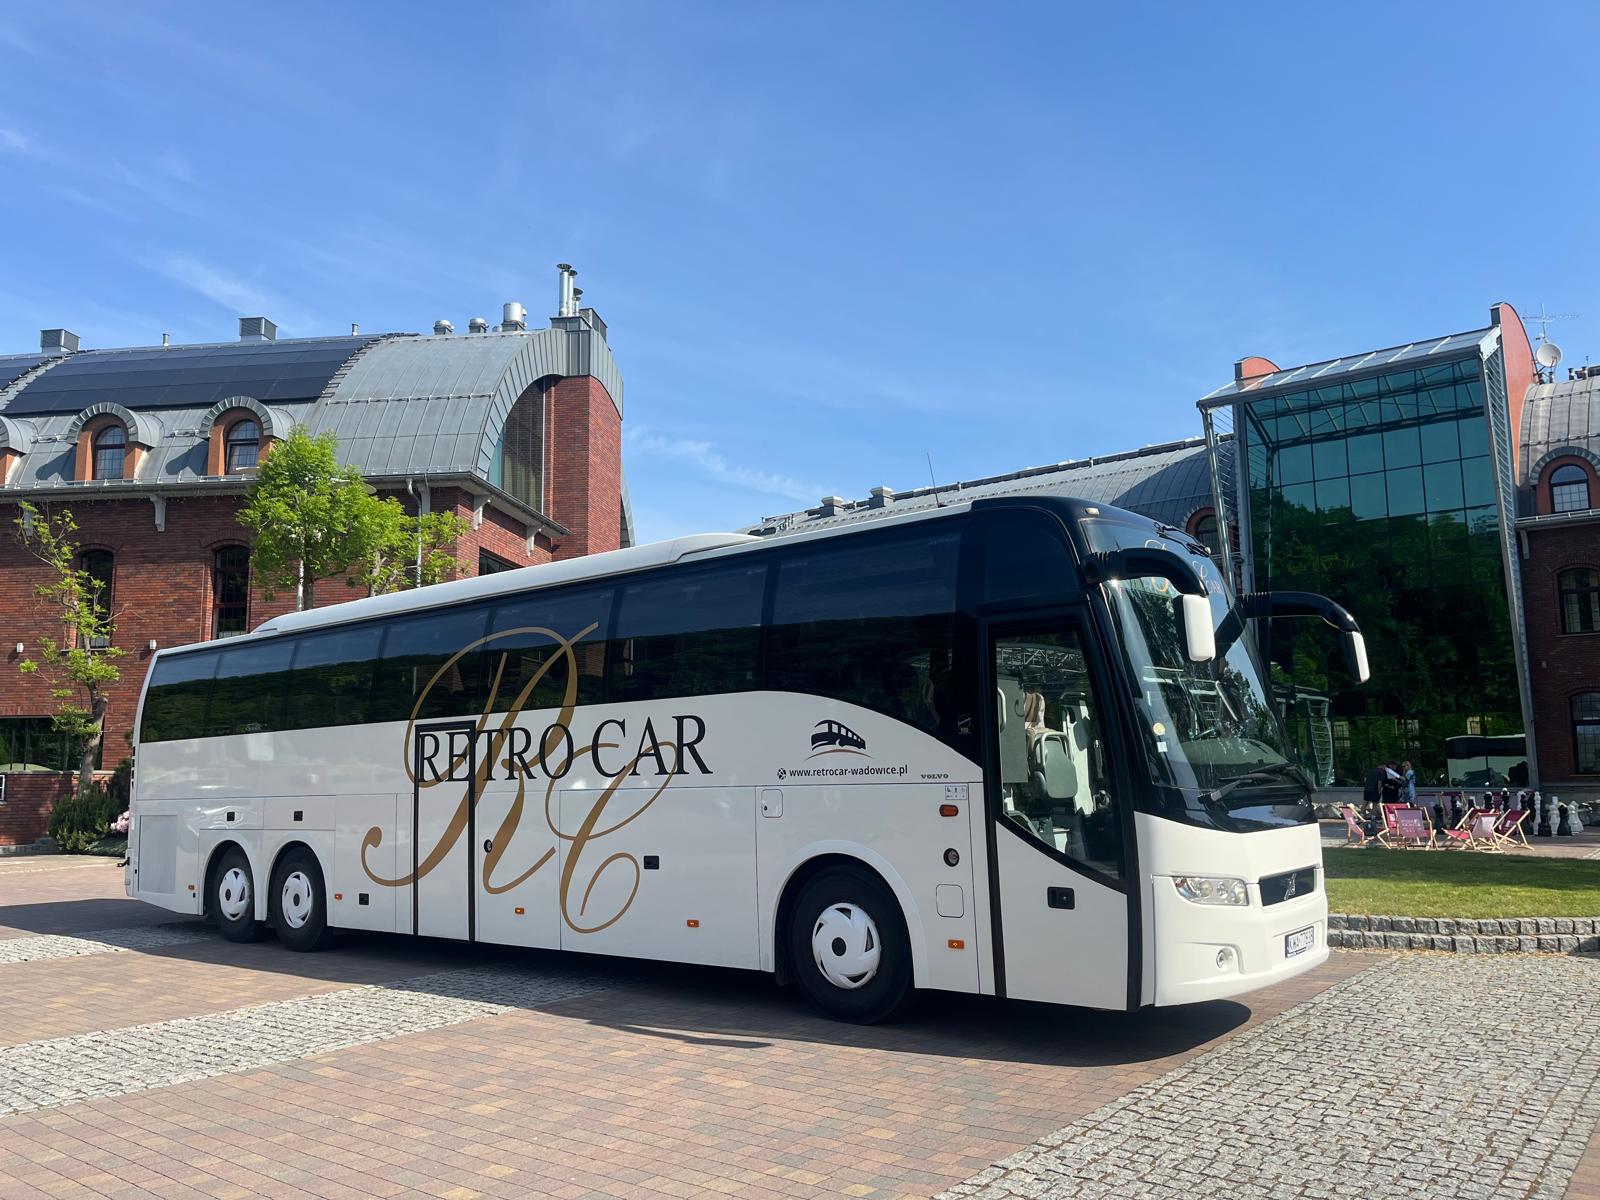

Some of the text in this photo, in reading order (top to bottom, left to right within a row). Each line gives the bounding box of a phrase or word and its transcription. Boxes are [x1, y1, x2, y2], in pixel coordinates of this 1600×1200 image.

[417, 714, 714, 783] RETRO CAR
[789, 764, 908, 777] www.retrocar-wadowice.pl
